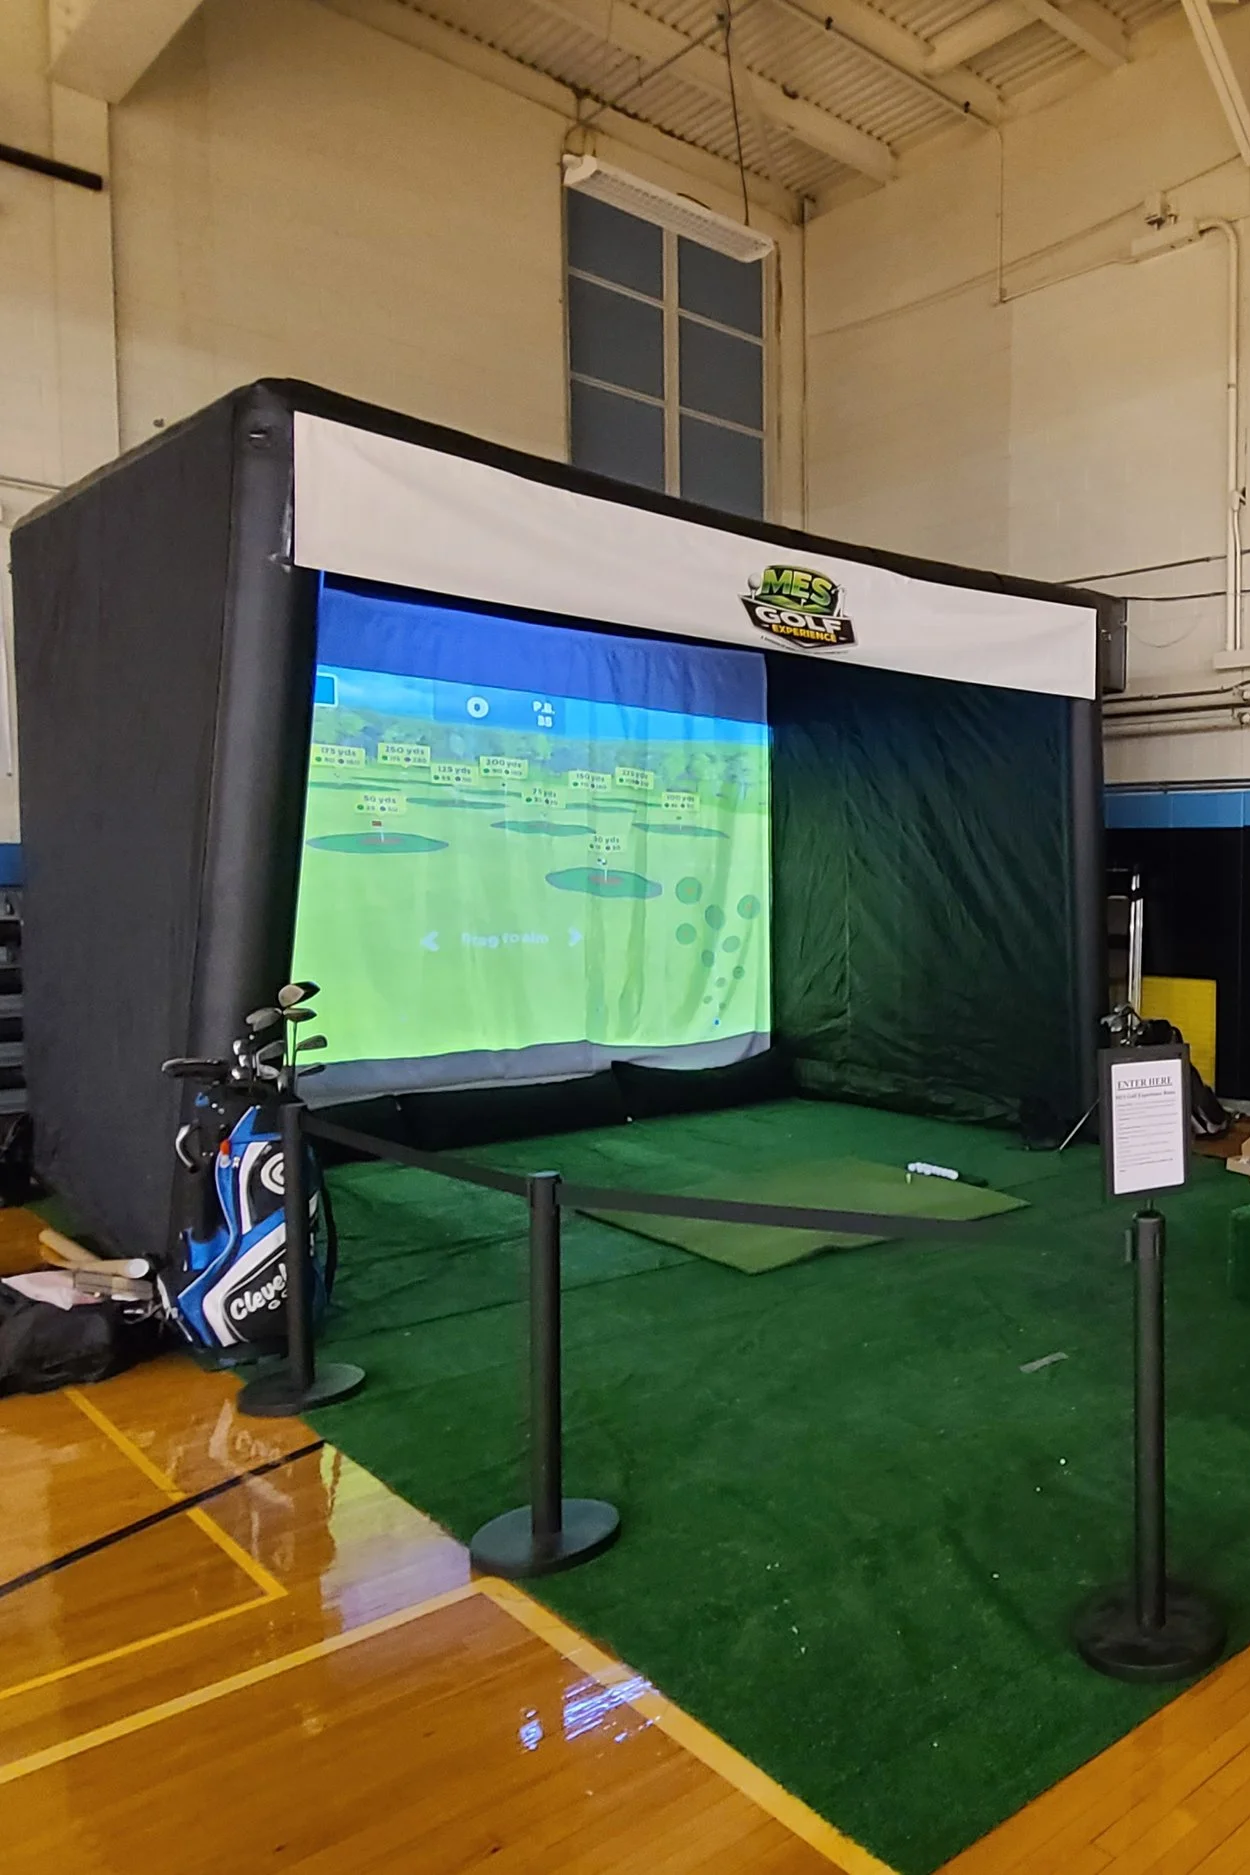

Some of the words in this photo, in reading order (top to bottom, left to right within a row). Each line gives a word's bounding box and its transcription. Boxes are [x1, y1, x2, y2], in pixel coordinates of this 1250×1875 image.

[761, 569, 832, 606] MES
[755, 606, 841, 634] GOLF
[772, 624, 837, 643] EXPERIENCE
[406, 748, 425, 757] yds
[1117, 1079, 1147, 1090] ENTER
[1149, 1076, 1173, 1087] HERE
[230, 1263, 287, 1320] Clevel
